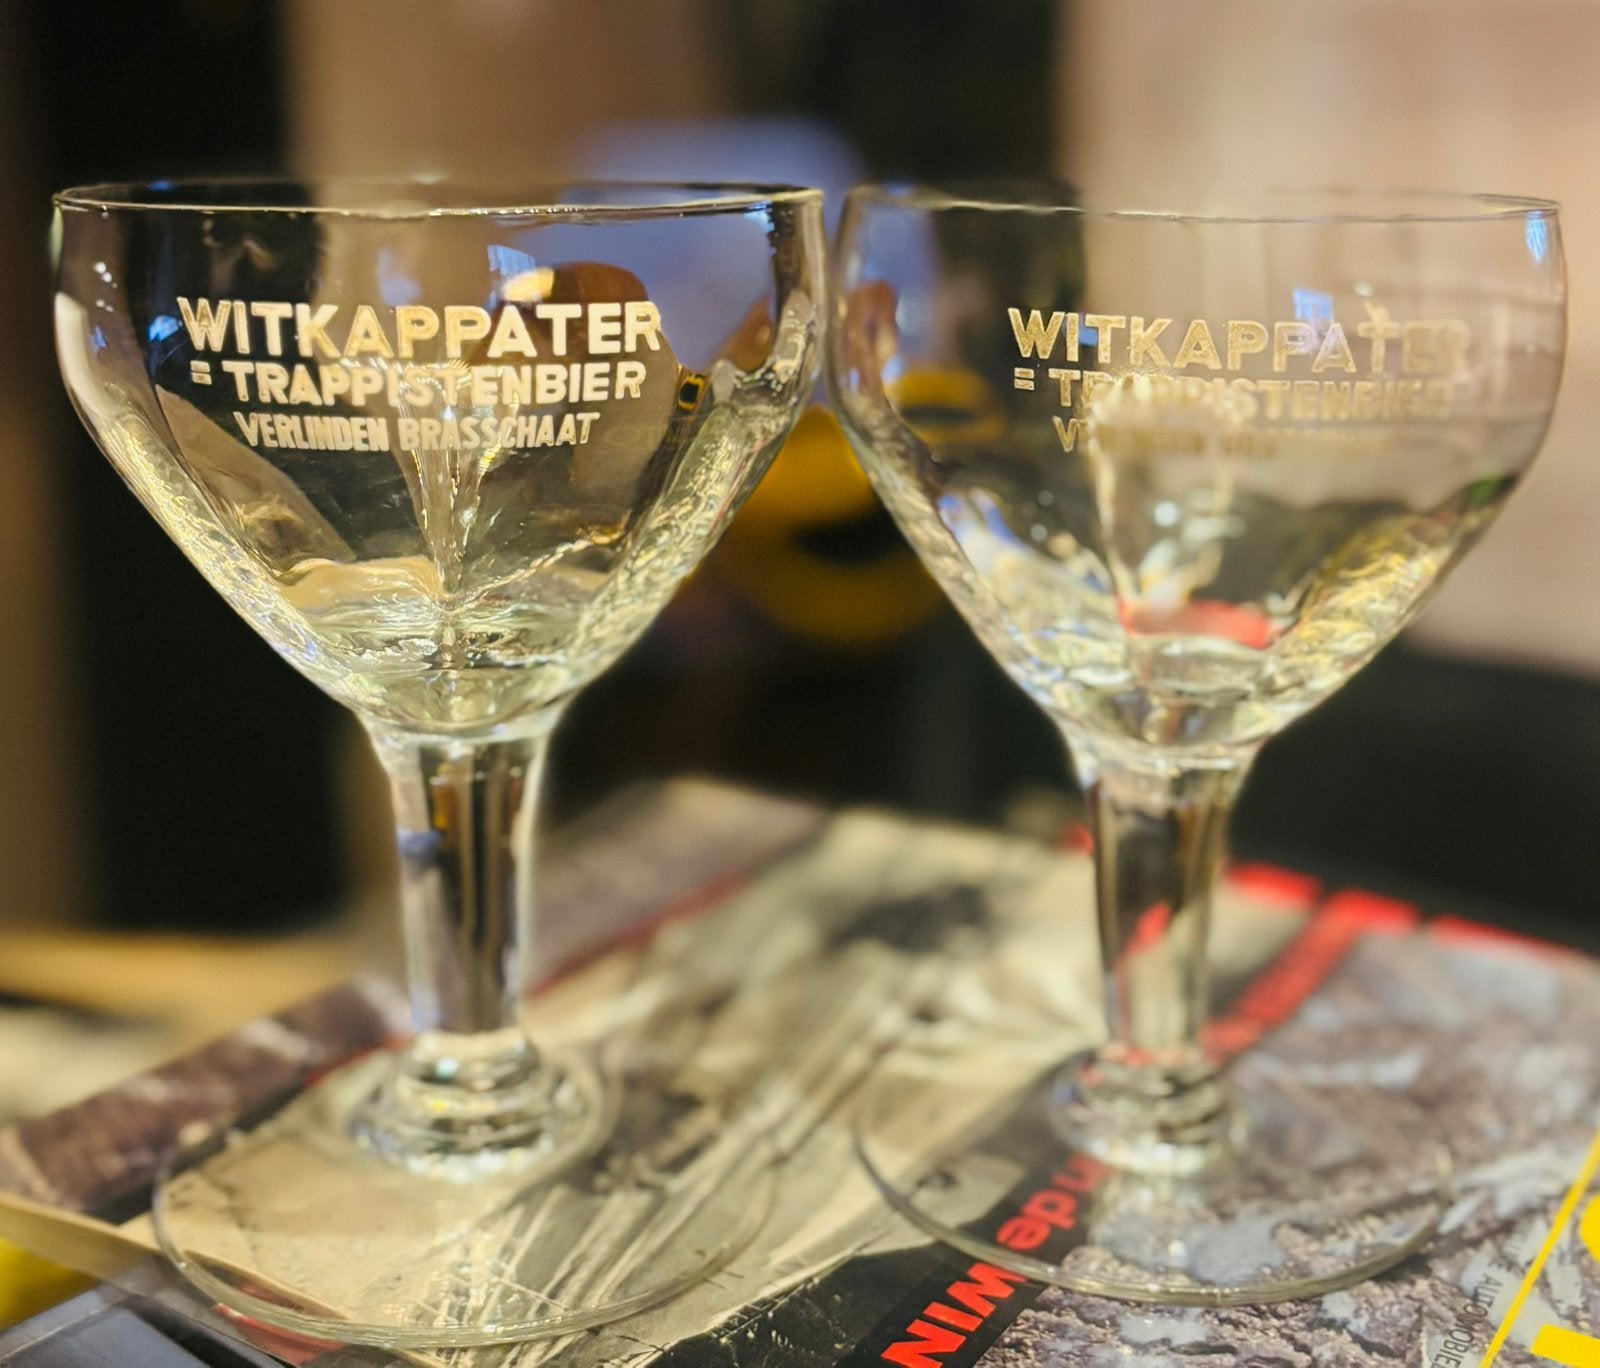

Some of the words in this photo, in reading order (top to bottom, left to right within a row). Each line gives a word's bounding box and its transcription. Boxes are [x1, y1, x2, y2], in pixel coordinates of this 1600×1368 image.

[176, 297, 662, 358] WITKAPPATER
[1007, 307, 1472, 376] WITKAPPATER
[222, 361, 646, 407] TRAPPISTENBIER
[234, 411, 390, 451] VERLINDEN
[400, 412, 600, 452] BRASSCHAAT
